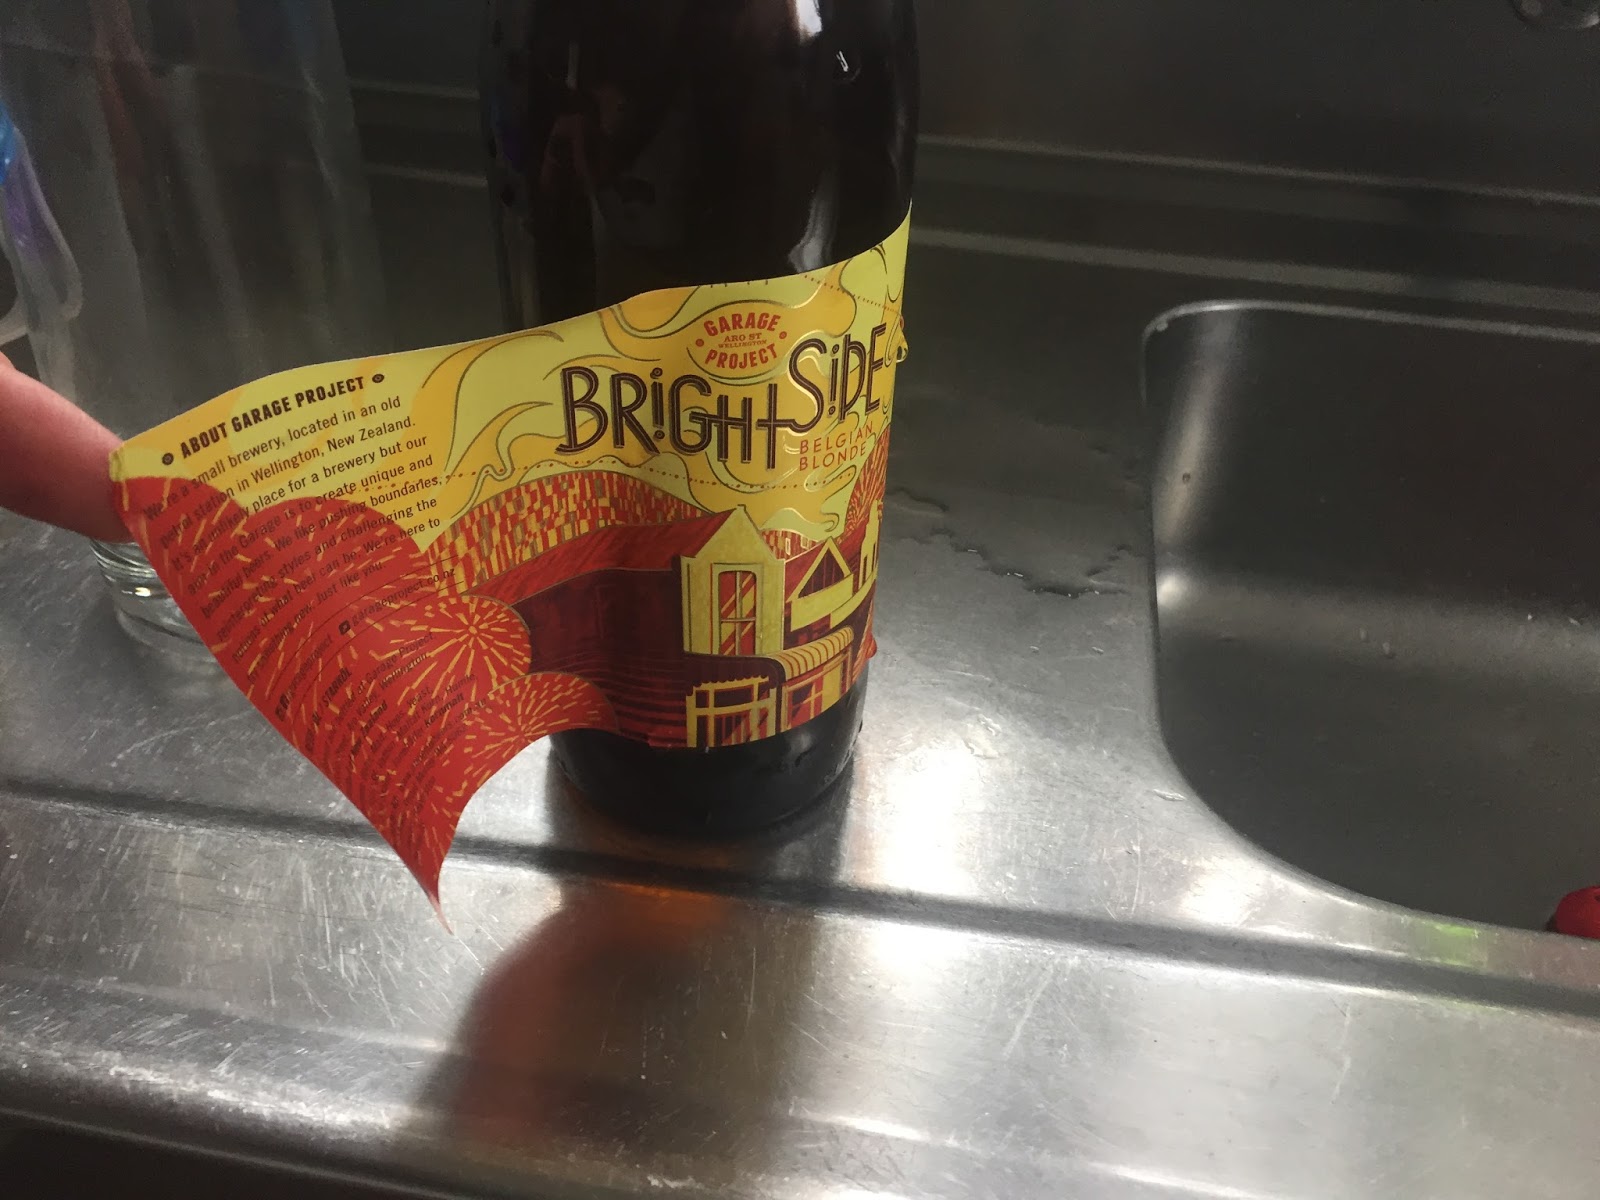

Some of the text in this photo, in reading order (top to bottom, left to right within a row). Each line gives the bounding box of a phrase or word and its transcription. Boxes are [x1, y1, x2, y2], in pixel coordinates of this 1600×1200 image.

[704, 312, 781, 336] GARAGE
[704, 342, 777, 369] PROJECT
[718, 340, 767, 348] WELLINGTON
[723, 332, 762, 342] ARO ST
[180, 376, 364, 459] ABOUT GARAGE PROJECT
[191, 459, 226, 488] small
[227, 435, 286, 468] brewery,
[288, 413, 339, 442] located
[343, 409, 356, 422] in
[360, 404, 377, 418] an
[380, 396, 401, 412] old
[800, 420, 875, 454] BELGIAN
[160, 416, 416, 548] petrol station in Wellington, New Zealand.
[208, 506, 250, 543] unlikely
[252, 486, 286, 514] place
[288, 477, 307, 493] for
[311, 472, 320, 484] a
[322, 451, 376, 480] brewery
[379, 441, 403, 458] but
[406, 435, 428, 450] our
[799, 440, 868, 472] BLONDE
[219, 544, 239, 565] the
[238, 515, 282, 548] Garage
[284, 508, 296, 520] is
[299, 501, 312, 513] to
[316, 482, 357, 504] create
[360, 465, 406, 488] unique
[409, 454, 433, 471] and
[275, 536, 293, 551] We
[294, 522, 315, 540] like
[319, 500, 367, 529] pushing
[370, 475, 442, 507] boundaries,
[278, 550, 312, 579] styles
[314, 536, 337, 555] and
[340, 506, 414, 541] challenging
[416, 498, 437, 512] the
[294, 573, 317, 595] beer
[319, 558, 341, 576] can
[363, 533, 397, 554] We're
[399, 520, 426, 540] here
[428, 518, 441, 530] to
[340, 572, 360, 588] like
